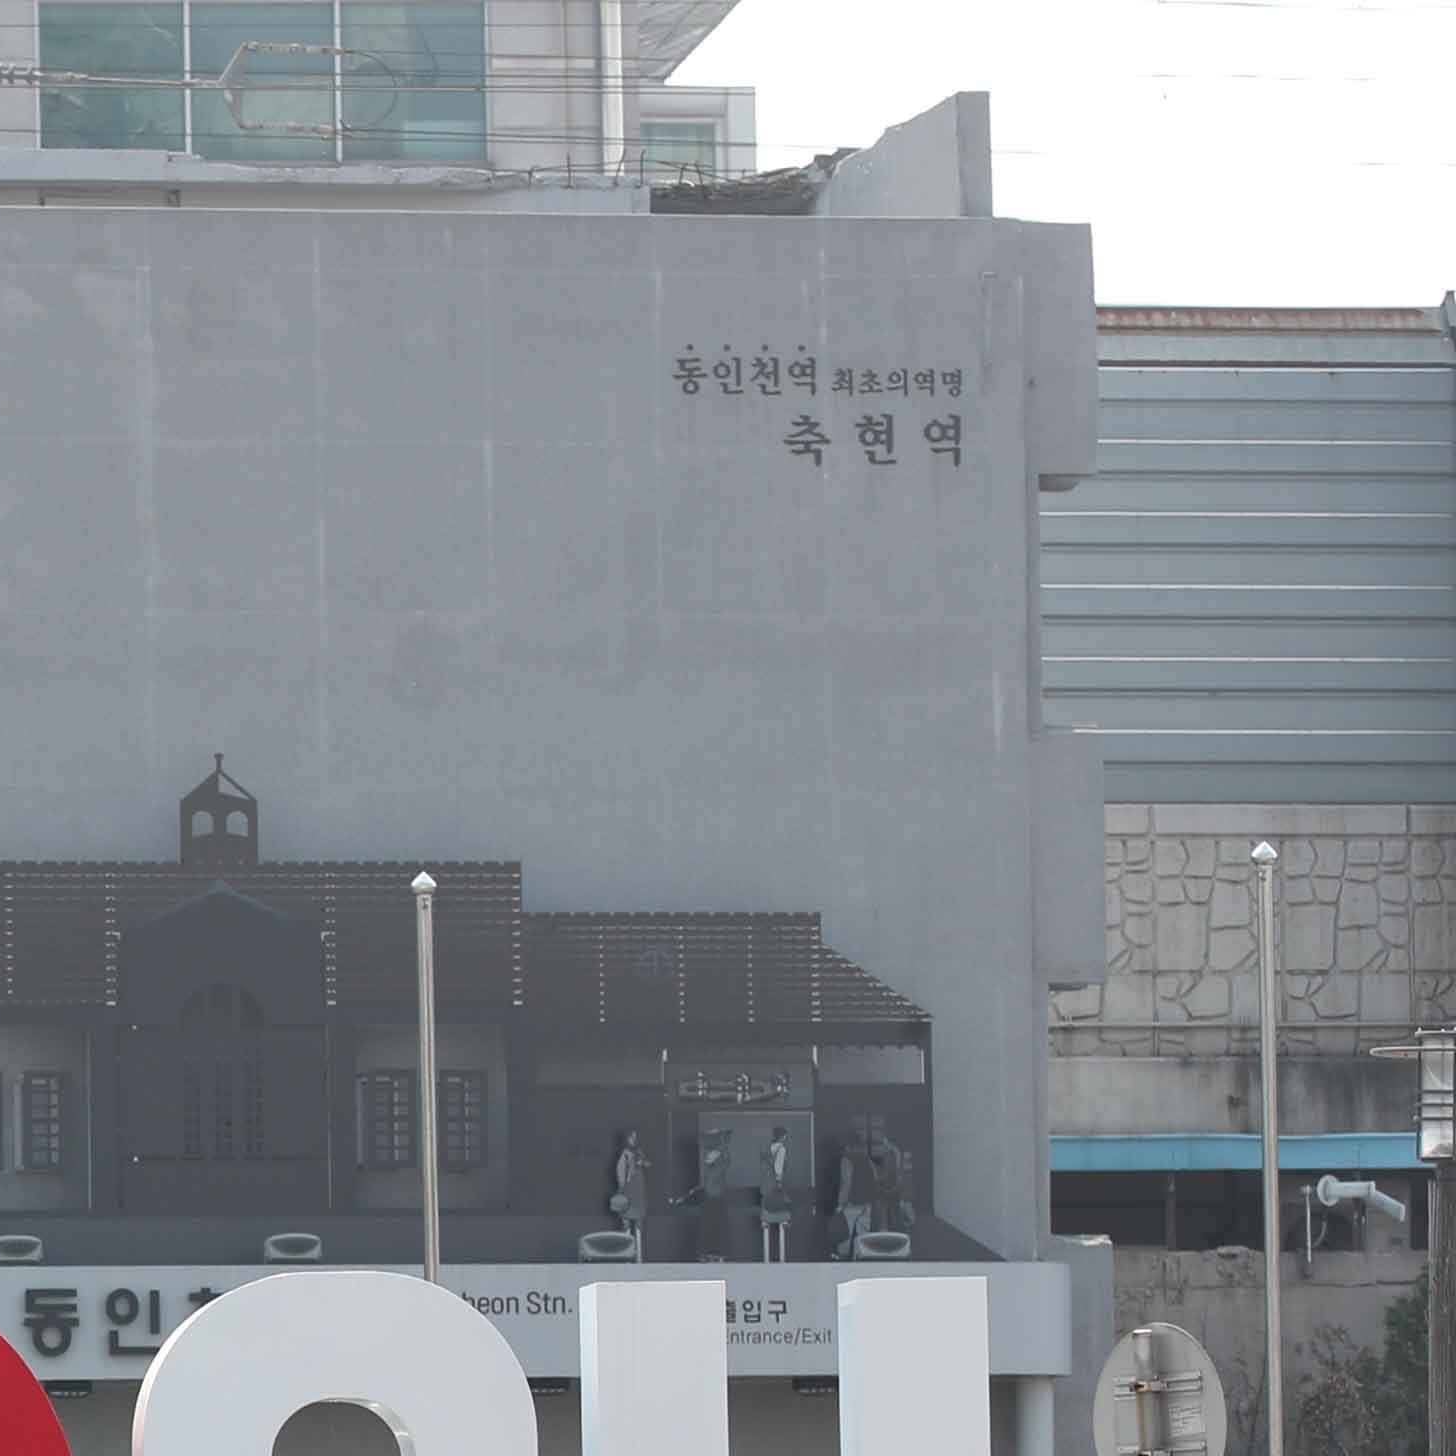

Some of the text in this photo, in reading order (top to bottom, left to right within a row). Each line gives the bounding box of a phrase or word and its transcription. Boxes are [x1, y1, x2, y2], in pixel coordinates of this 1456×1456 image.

[672, 355, 817, 397] 동인천역
[783, 413, 962, 467] 축현역
[22, 1286, 225, 1357] 동인
[526, 1291, 574, 1315] Stn.
[727, 1327, 833, 1348] ntrance/Exit
